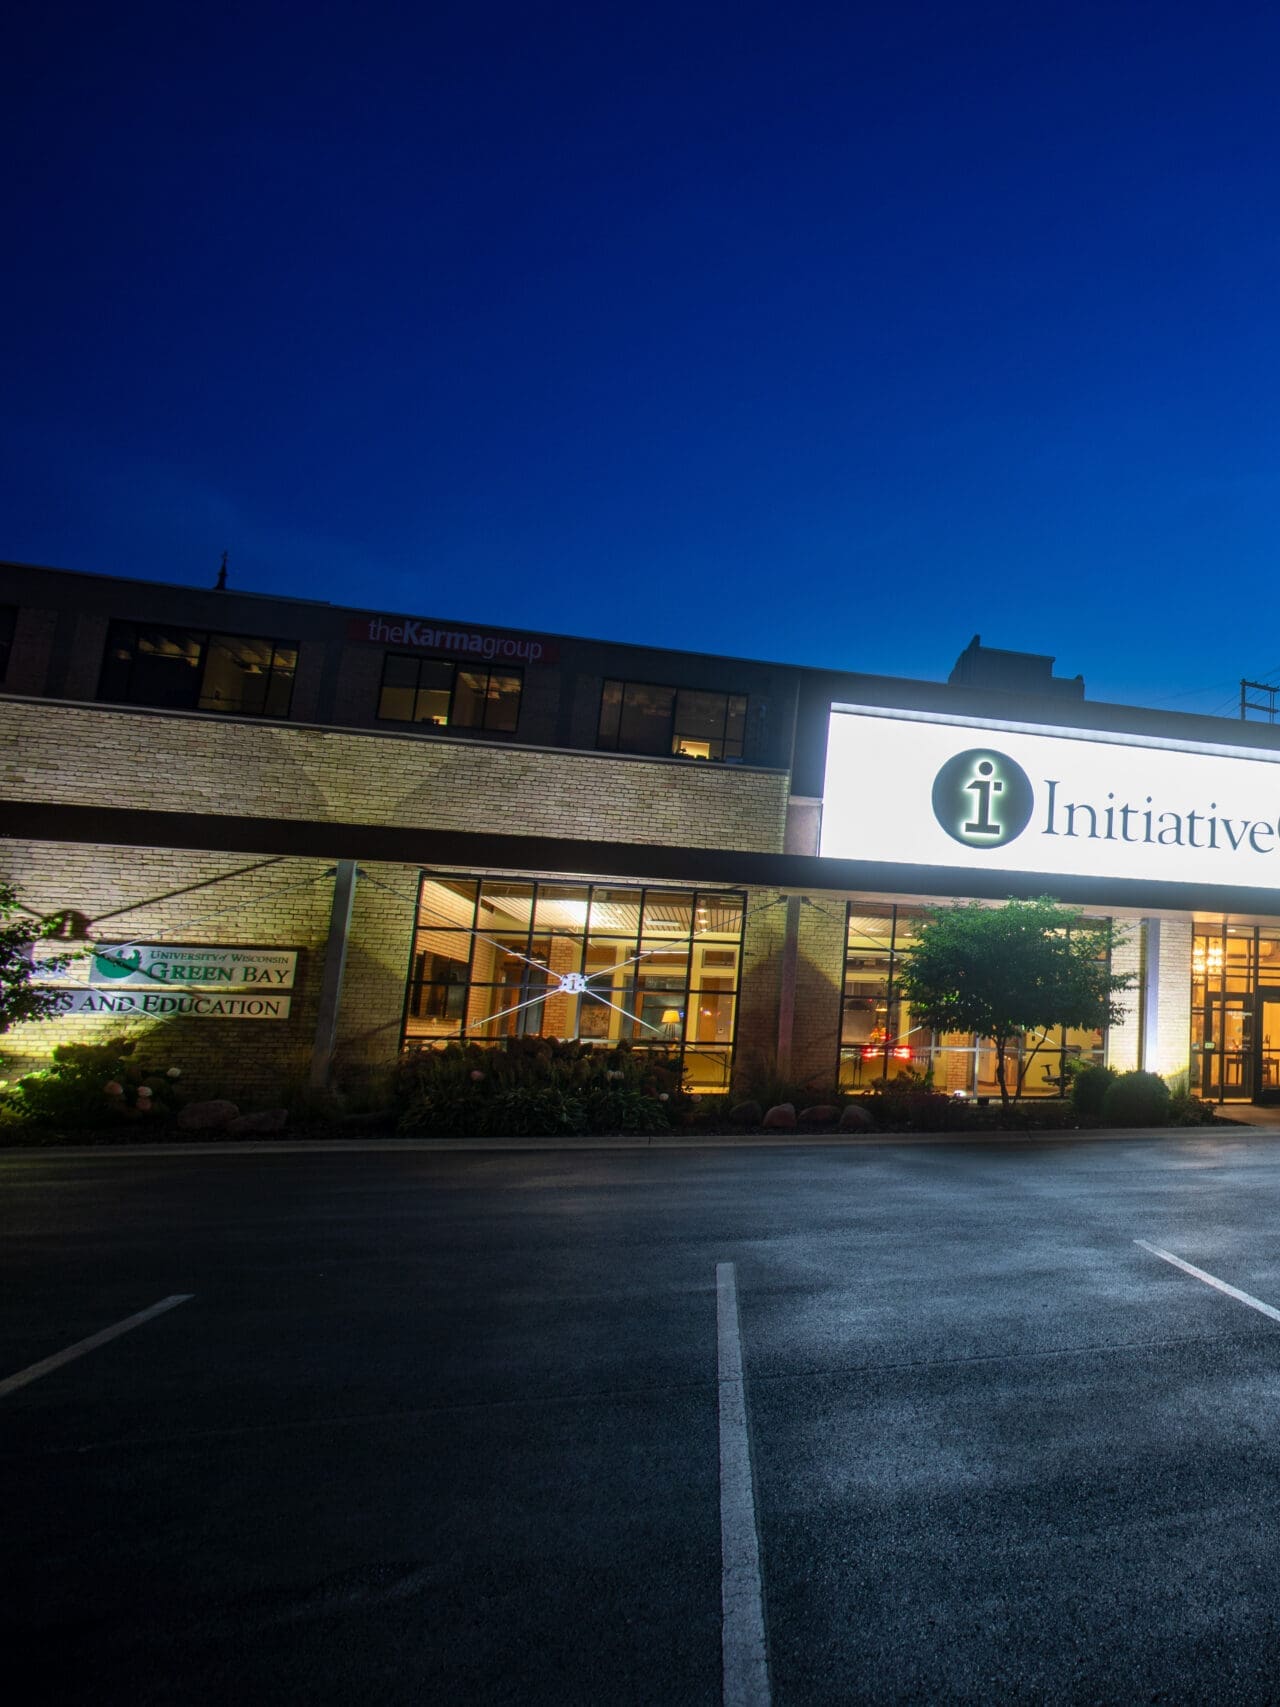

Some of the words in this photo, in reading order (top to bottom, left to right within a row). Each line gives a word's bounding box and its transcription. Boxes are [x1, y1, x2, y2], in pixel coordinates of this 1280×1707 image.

[146, 962, 232, 981] GREEN
[243, 966, 290, 984] BAY
[79, 995, 135, 1012] AND
[143, 994, 280, 1015] EDUCATION
